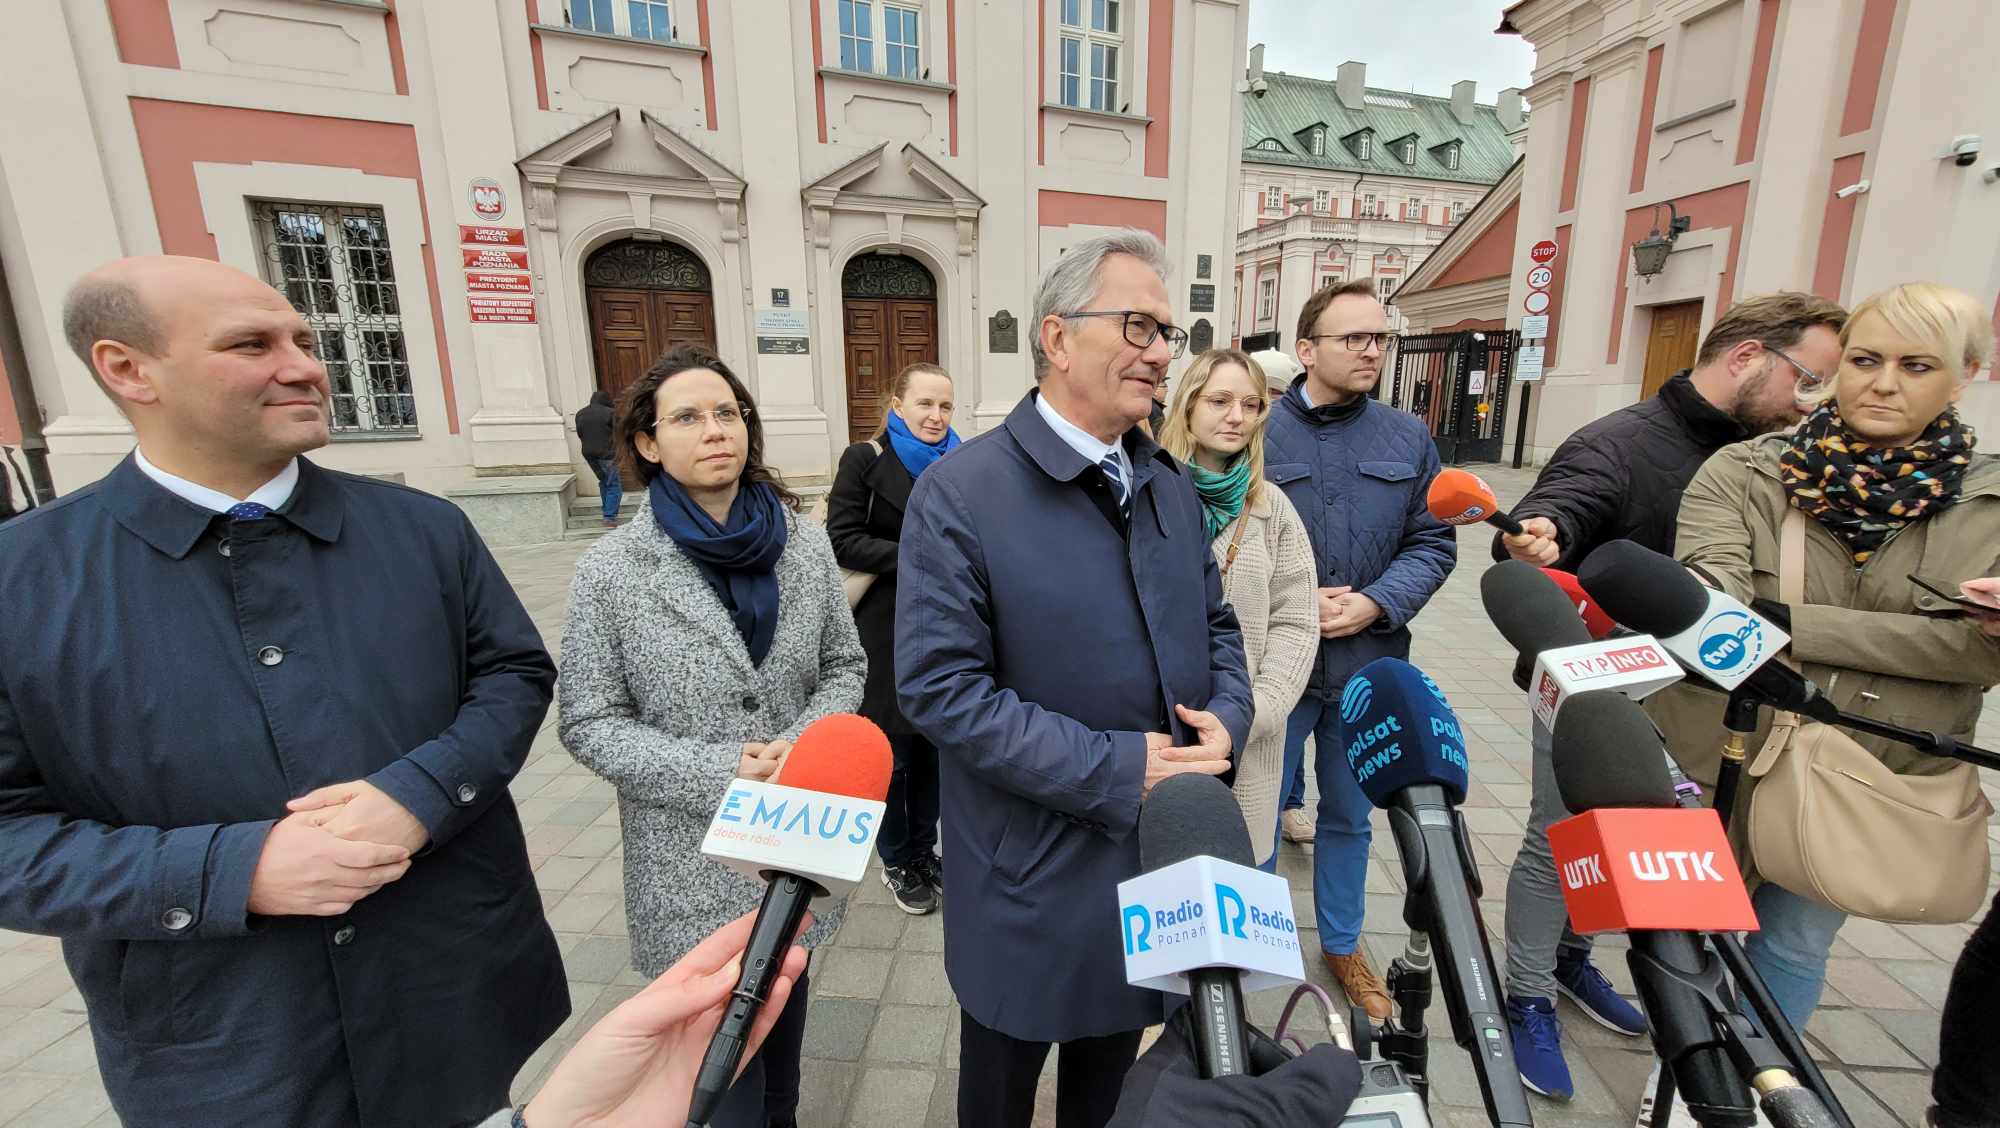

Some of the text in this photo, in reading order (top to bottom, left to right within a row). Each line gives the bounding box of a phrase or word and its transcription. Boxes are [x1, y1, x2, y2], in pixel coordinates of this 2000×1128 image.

[475, 234, 509, 242] MIASTA
[1533, 246, 1555, 257] STOP
[479, 255, 512, 263] MIASTA
[1532, 271, 1550, 284] 20
[1563, 649, 1661, 677] TVP INFO
[1346, 715, 1402, 769] polsat
[1358, 742, 1402, 783] news
[720, 789, 873, 845] EMAUS
[1563, 853, 1607, 890] WTK
[1628, 851, 1725, 881] WTK
[1156, 899, 1203, 929] Radio
[1251, 905, 1295, 933] Radio
[1214, 1005, 1232, 1076] SENNHEI
